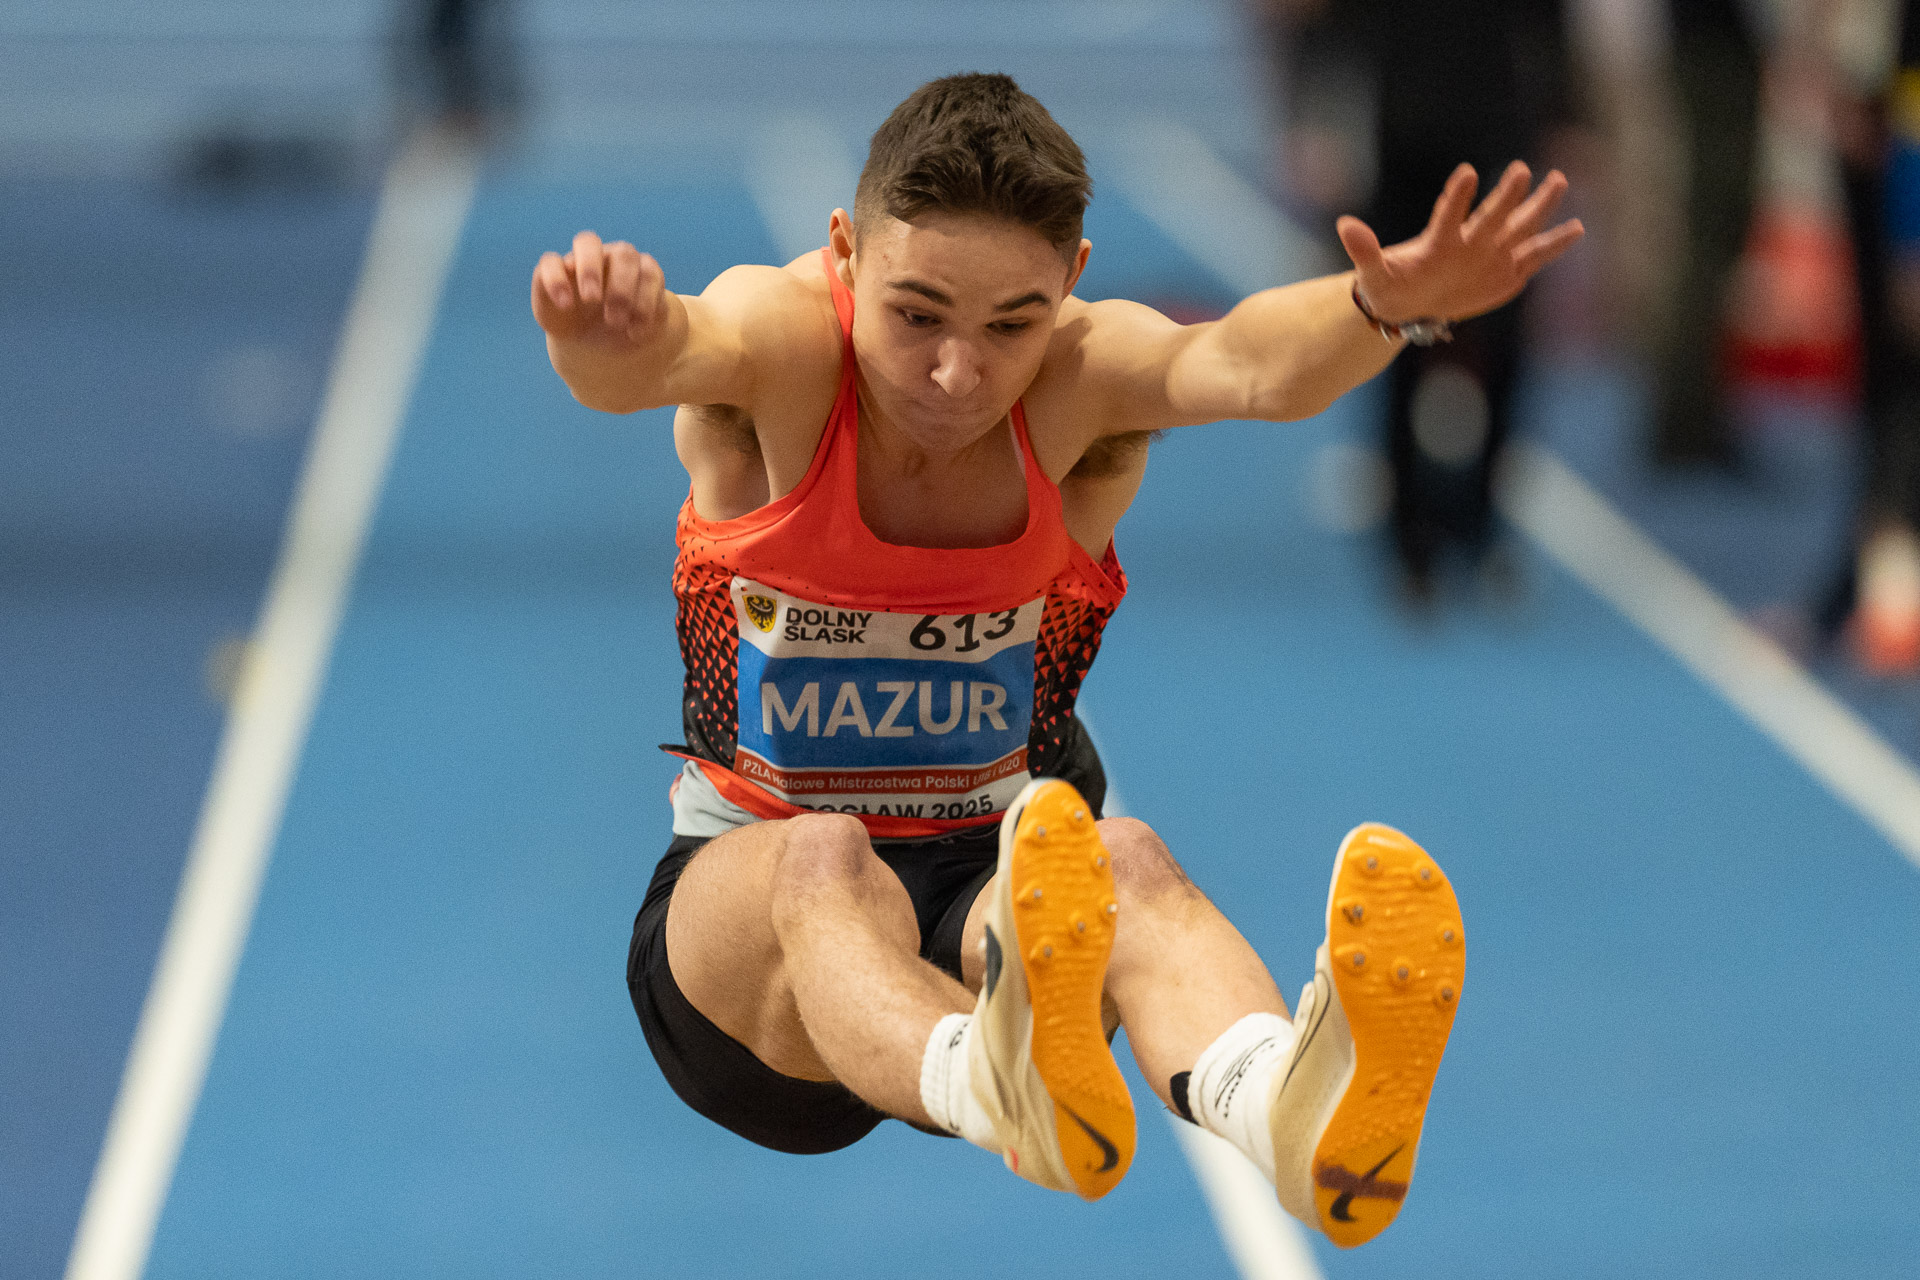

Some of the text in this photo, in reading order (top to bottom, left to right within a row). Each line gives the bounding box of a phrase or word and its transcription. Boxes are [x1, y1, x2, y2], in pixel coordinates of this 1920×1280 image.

[785, 607, 873, 628] DOLNY
[909, 607, 1019, 652] 613
[761, 680, 1009, 738] MAZUR
[742, 759, 772, 781] PZLA
[772, 772, 825, 790] Halowe
[829, 776, 921, 790] Mistrzostwa
[925, 774, 970, 789] Polski
[998, 755, 1020, 774] U20
[931, 793, 994, 820] 2025
